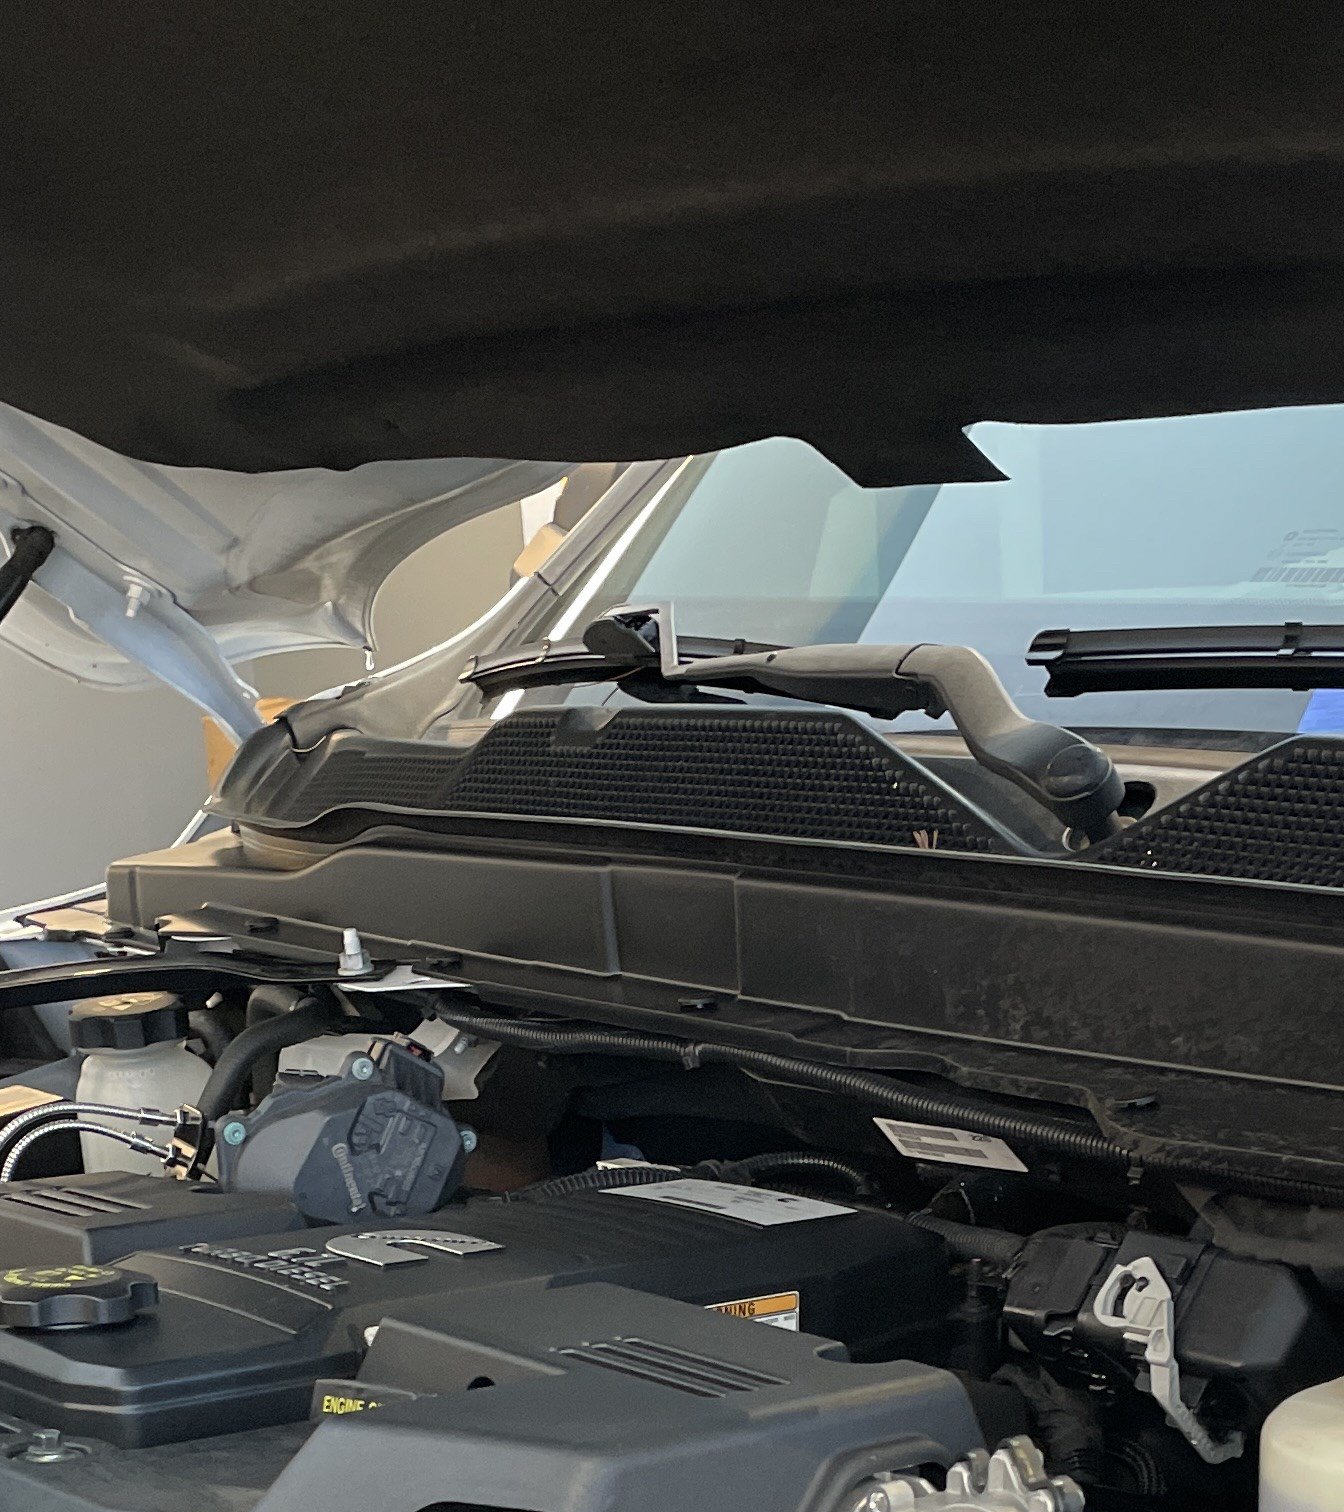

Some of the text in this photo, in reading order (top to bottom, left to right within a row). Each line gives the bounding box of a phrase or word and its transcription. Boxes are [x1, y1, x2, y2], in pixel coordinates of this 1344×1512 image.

[330, 1142, 367, 1214] Continental
[253, 1259, 351, 1291] DIESEL
[322, 1395, 365, 1415] ENGINE
